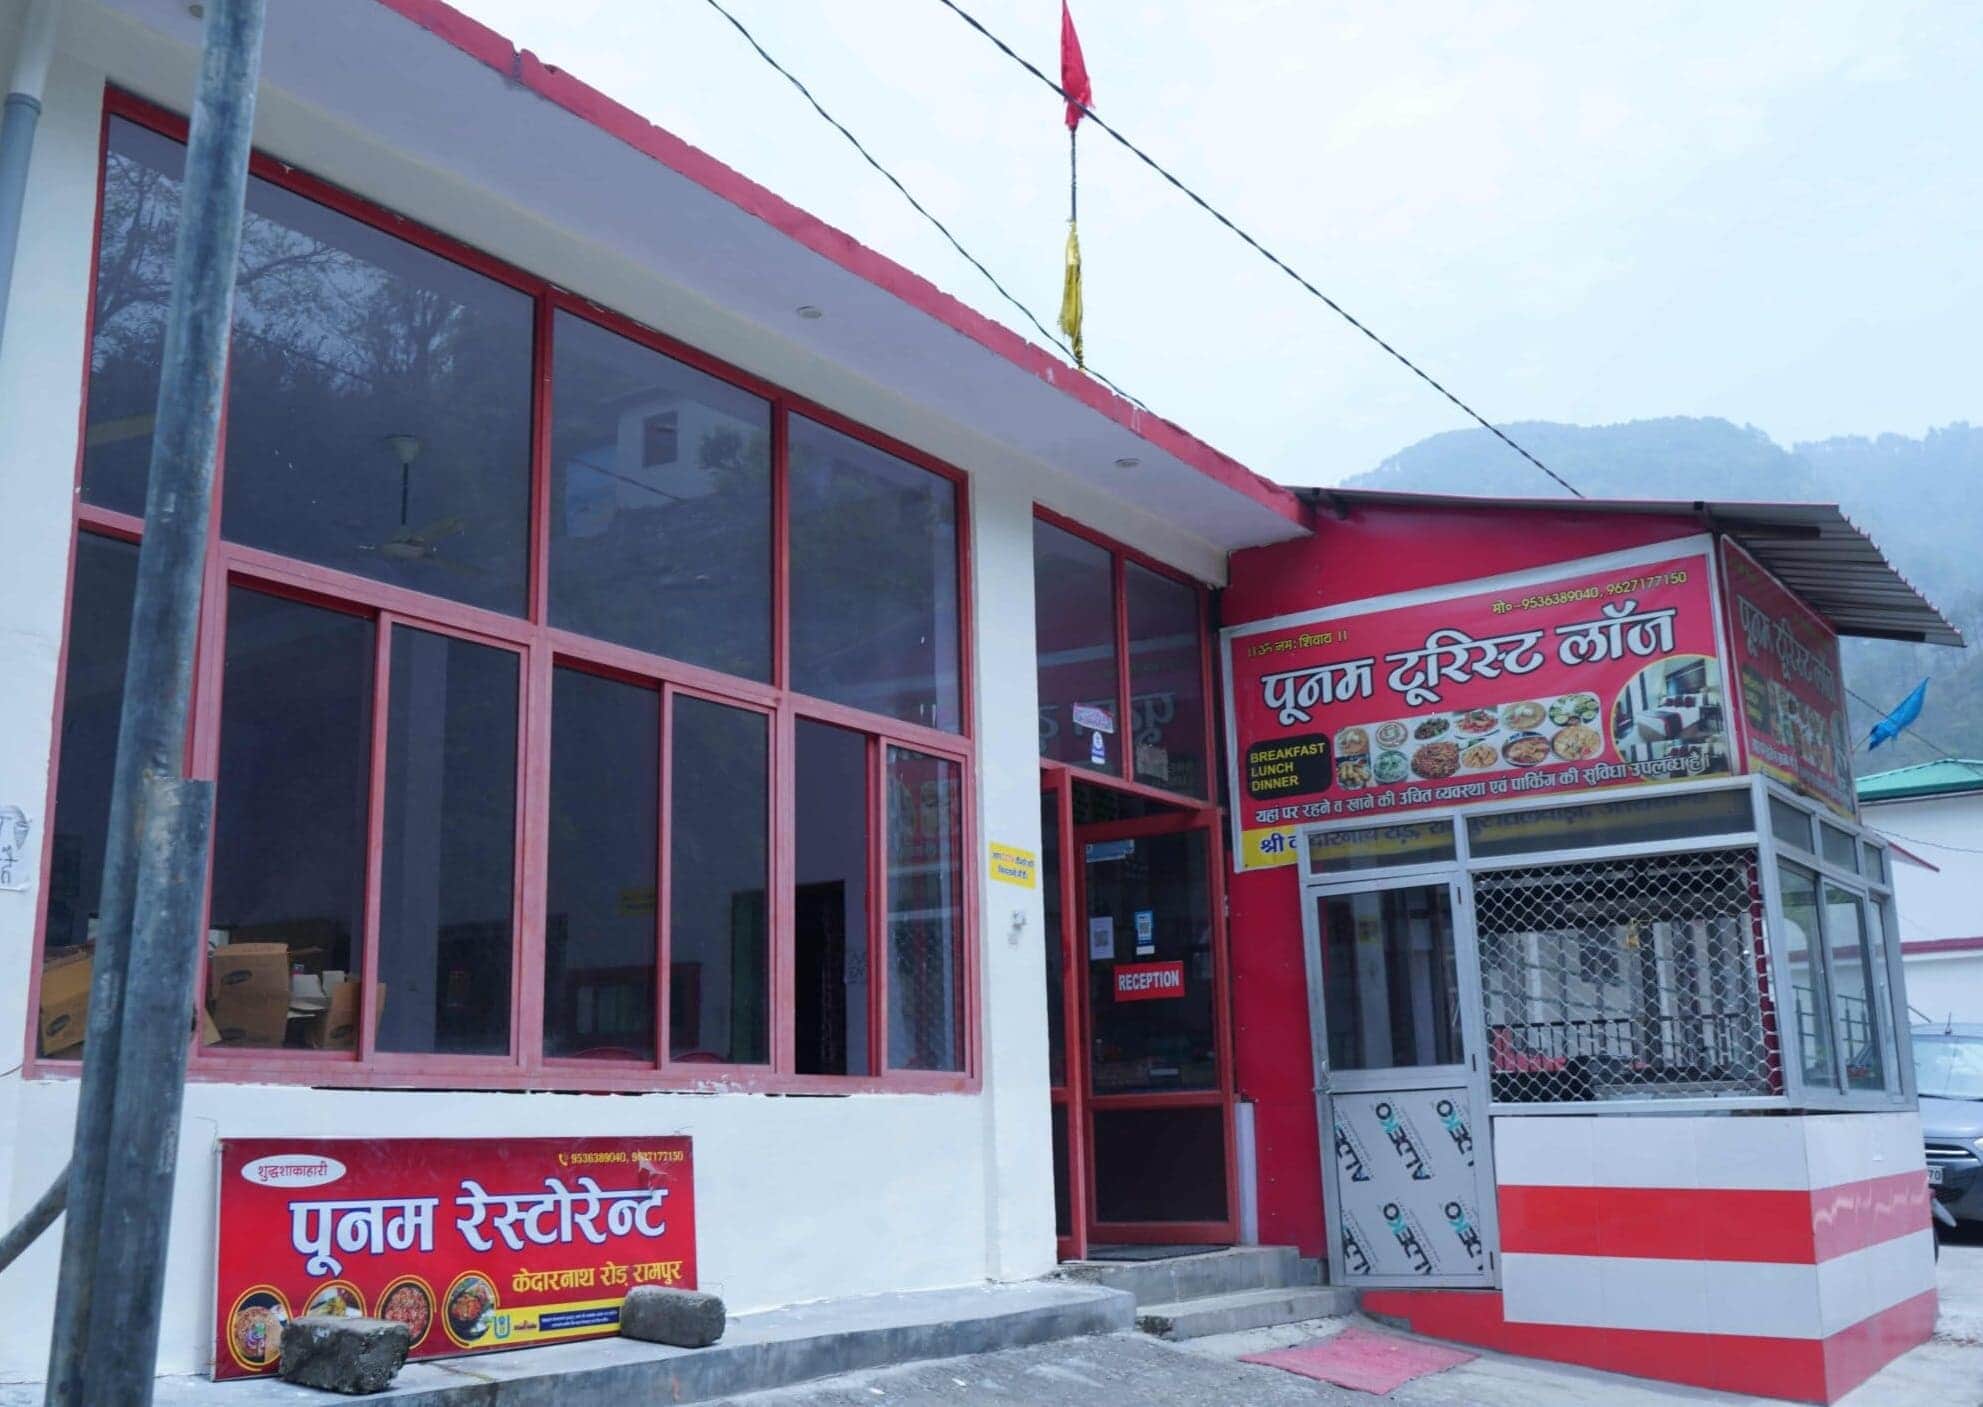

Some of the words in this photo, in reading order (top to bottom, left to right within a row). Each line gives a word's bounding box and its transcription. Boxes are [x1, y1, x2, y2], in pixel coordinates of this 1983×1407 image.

[1606, 571, 1687, 595] 9627177150
[1261, 657, 1375, 726] पूनम
[1385, 628, 1544, 706] टूरिस्ट
[1556, 600, 1676, 665] लॉज
[1250, 742, 1325, 763] BREAKFAST
[1251, 763, 1293, 777] LUNCH
[1251, 775, 1299, 792] DINNER
[1282, 806, 1299, 819] पर
[1302, 799, 1330, 817] रहने
[1334, 801, 1342, 813] व
[1348, 794, 1374, 811] खाने
[1378, 791, 1395, 807] की
[1400, 786, 1432, 805] उचित
[1436, 780, 1485, 800] व्यवस्था
[1490, 777, 1507, 794] एवं
[1511, 771, 1556, 791] पार्किंग
[1560, 766, 1578, 785] की
[1583, 762, 1627, 785] सुविधा
[1631, 757, 1687, 778] उपलब्ध
[1260, 832, 1284, 854] श्री
[1118, 970, 1180, 991] RECEPTION
[258, 1160, 328, 1181] शुद्धशाकाहारी
[288, 1196, 440, 1278] पूनम
[455, 1176, 669, 1252] रेस्टोरेन्ट
[512, 1267, 595, 1293] केदारनाथ
[632, 1260, 684, 1286] रामपुर
